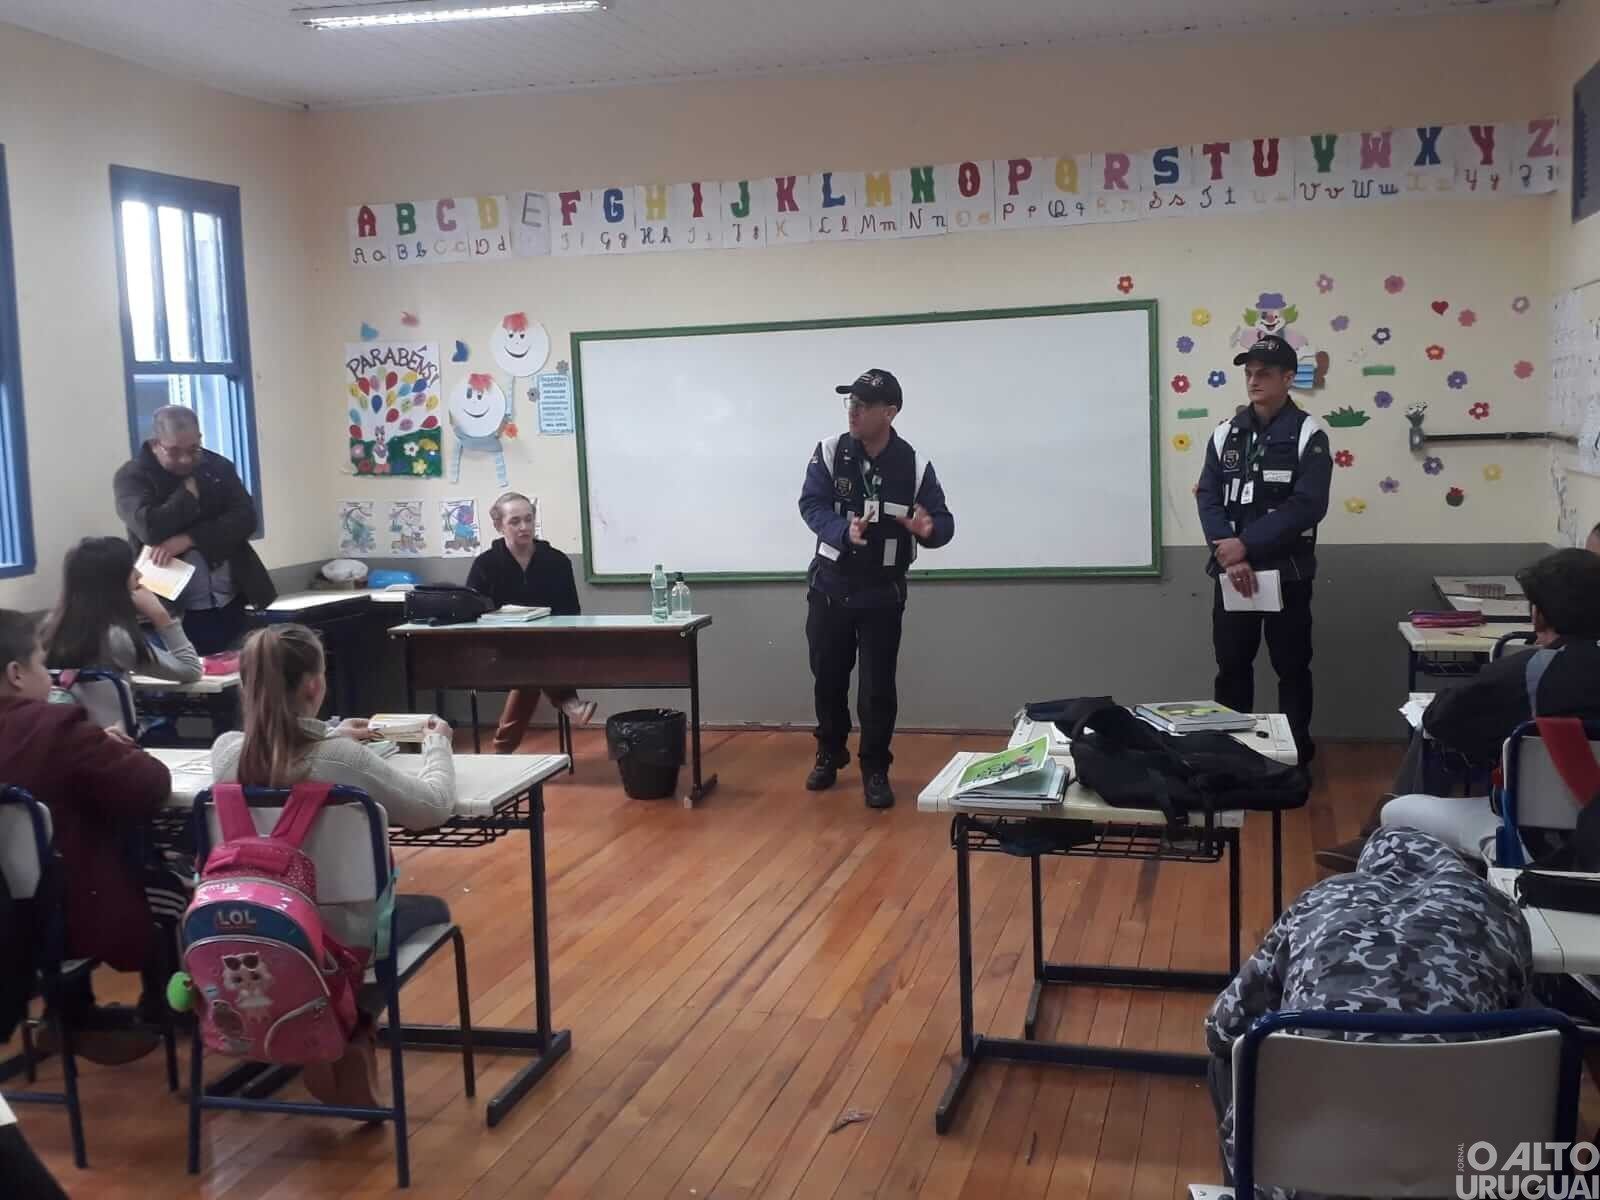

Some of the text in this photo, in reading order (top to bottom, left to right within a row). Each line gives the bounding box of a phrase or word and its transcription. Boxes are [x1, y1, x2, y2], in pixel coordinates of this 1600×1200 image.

[358, 119, 1555, 238] A B C D E F G H I J K L M N O P Q R S T U V W X Y Z
[346, 344, 440, 388] PARABÉNS!
[218, 910, 257, 925] LOL
